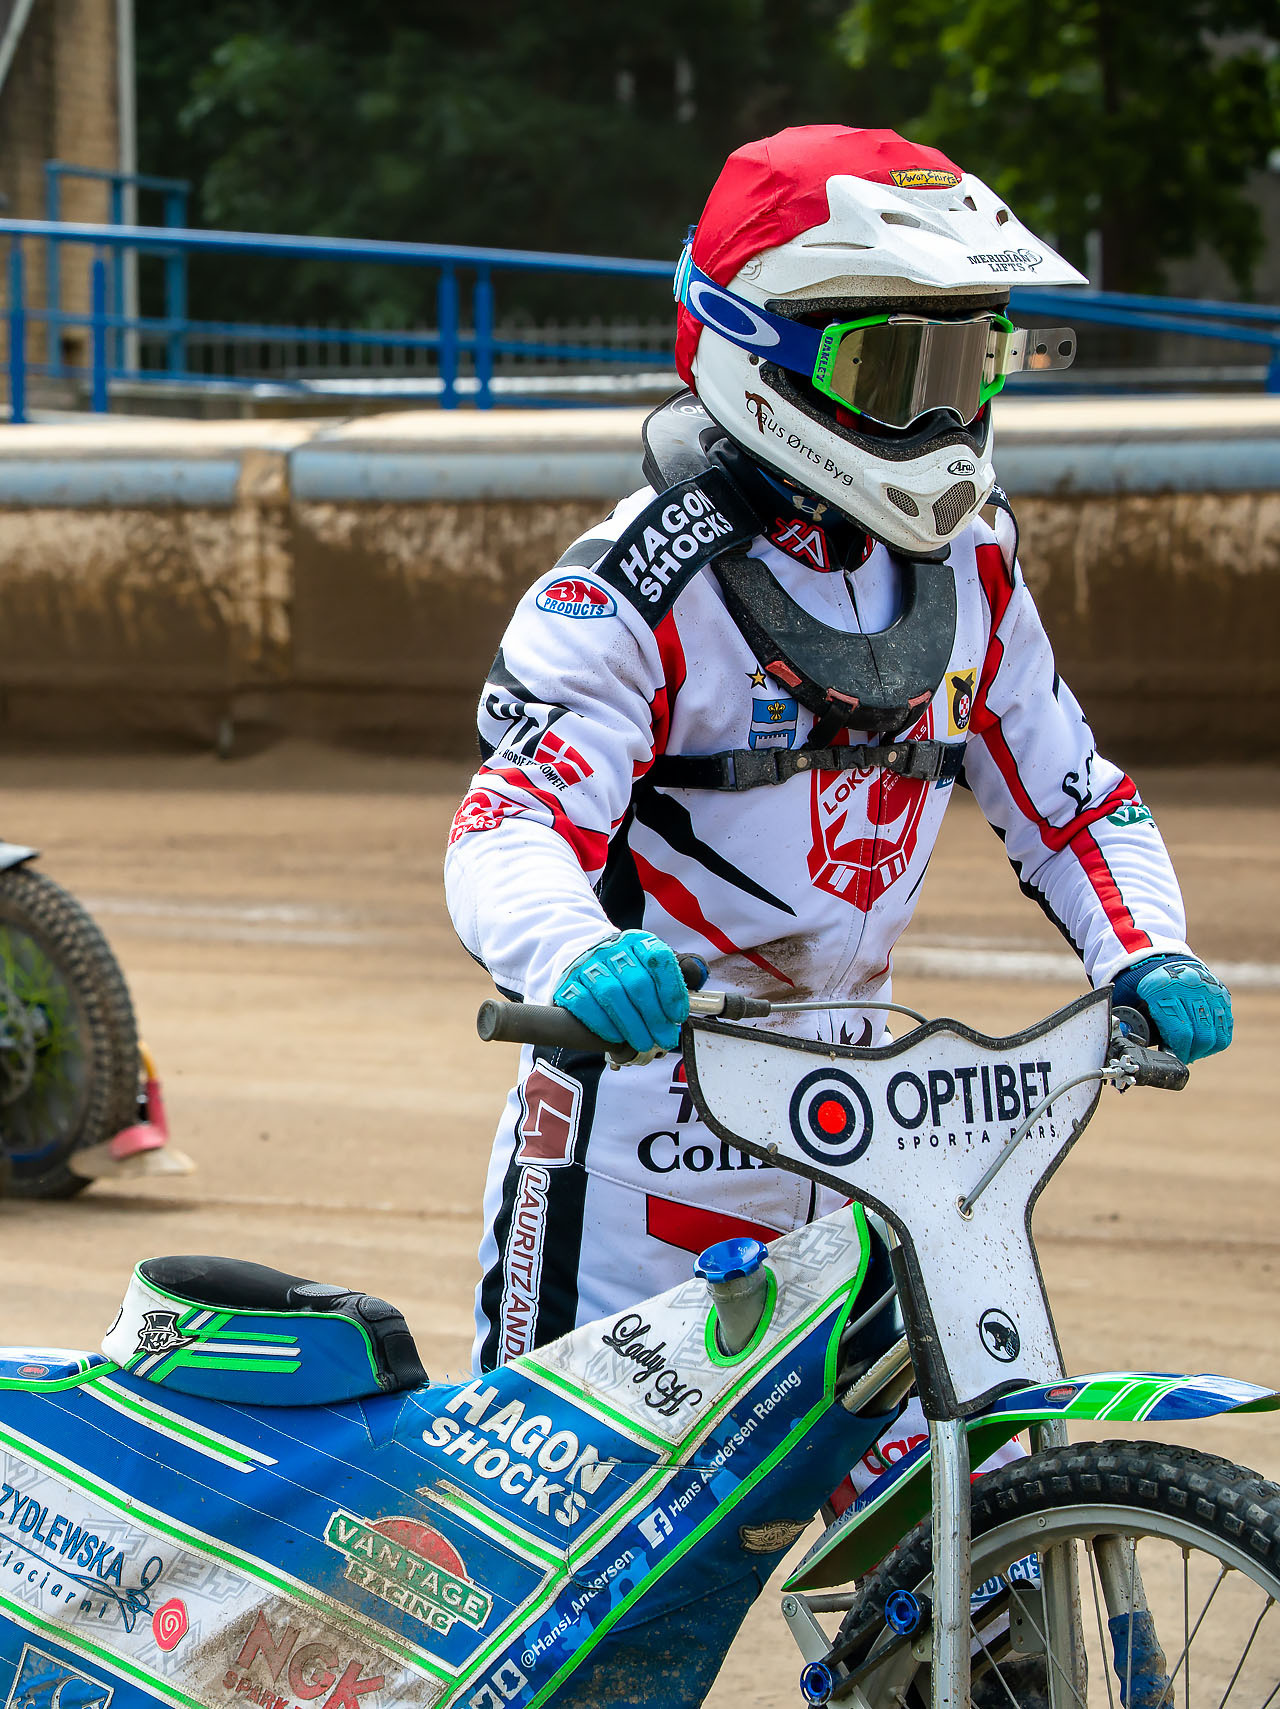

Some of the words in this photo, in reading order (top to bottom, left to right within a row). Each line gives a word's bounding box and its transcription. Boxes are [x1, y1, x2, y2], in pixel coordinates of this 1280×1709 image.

[966, 251, 1031, 266] MERIDIAN
[990, 262, 1025, 274] LIFTS
[816, 335, 834, 383] OAKLEY
[823, 457, 854, 486] Byg
[619, 488, 716, 586] HAGON
[640, 511, 734, 603] SHOCKS
[544, 598, 606, 616] PRODUCTS
[886, 1061, 1053, 1130] OPTIBET
[897, 1130, 990, 1150] SPORTA
[510, 1173, 543, 1293] LAURITZ
[601, 1313, 668, 1384] Lady
[422, 1416, 587, 1527] SHOCKS
[444, 1379, 622, 1495] HAGON
[669, 1481, 702, 1518] Hans
[700, 1417, 758, 1484] Andersen
[753, 1370, 803, 1422] Racing
[335, 1518, 487, 1620] VANTAGE
[347, 1563, 451, 1630] RACING
[222, 1670, 290, 1709] SPARK
[236, 1610, 385, 1709] NGK
